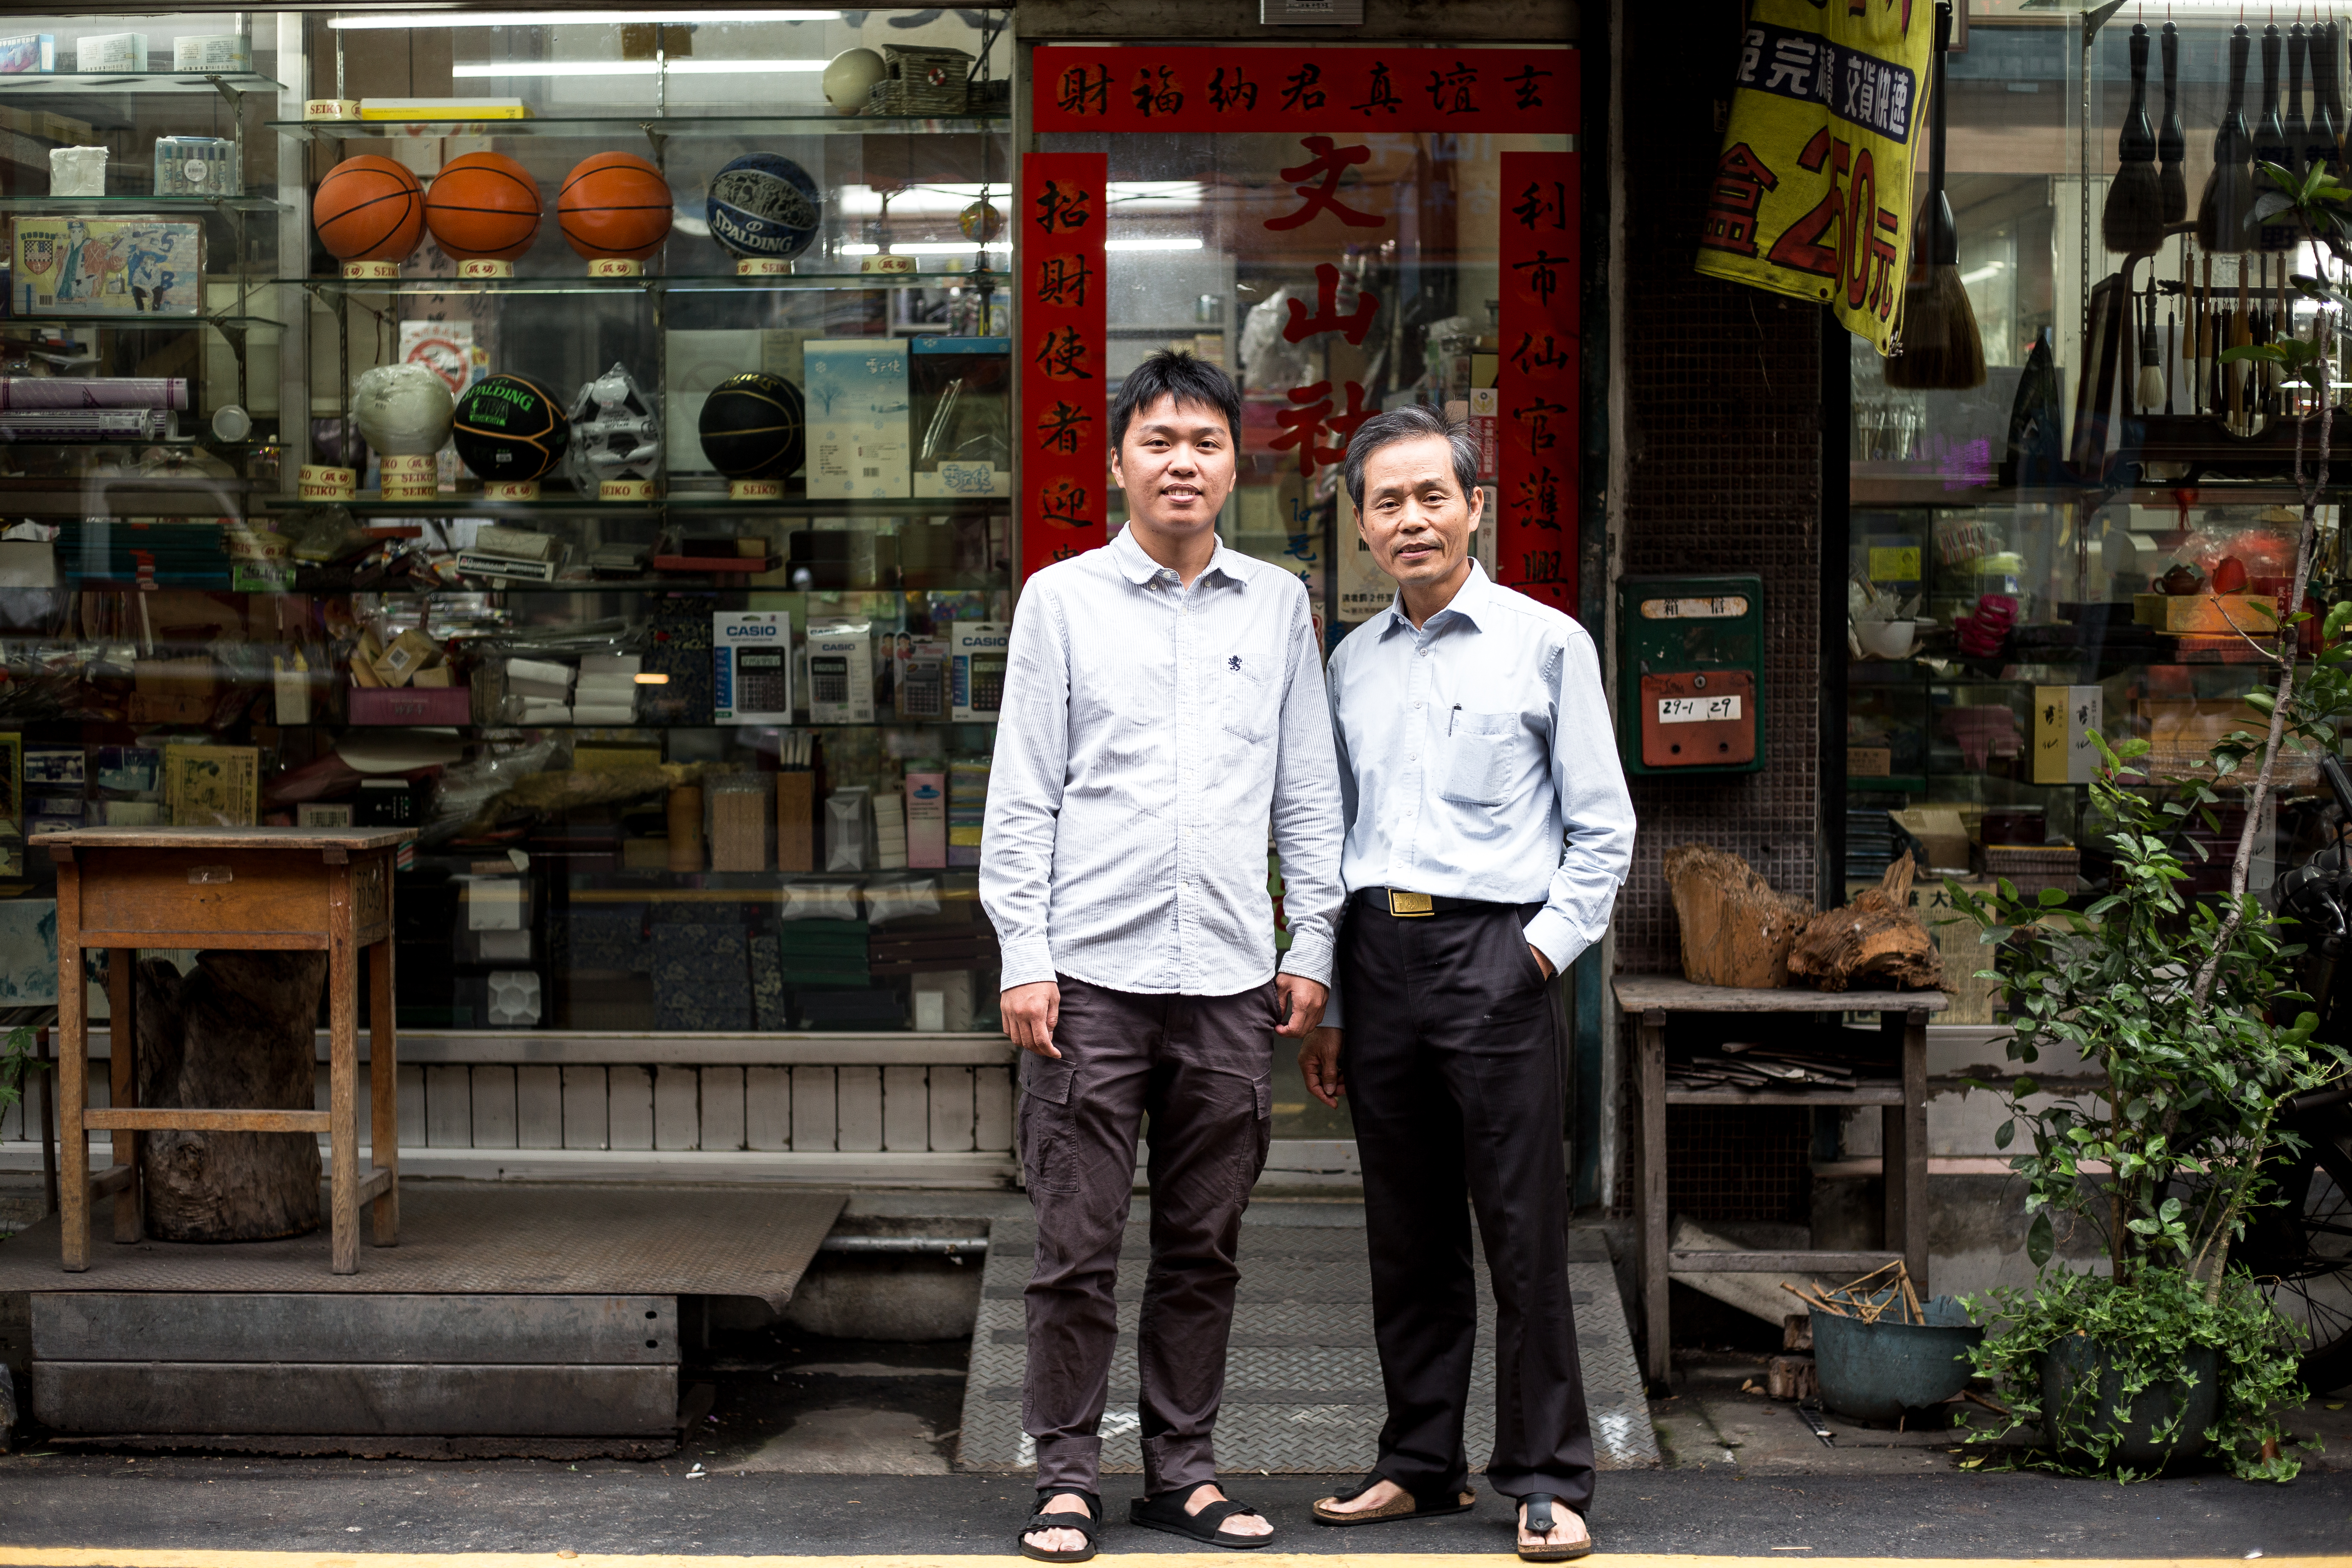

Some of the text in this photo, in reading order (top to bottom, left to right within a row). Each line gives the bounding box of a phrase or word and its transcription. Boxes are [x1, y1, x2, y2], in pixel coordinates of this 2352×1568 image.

[1845, 56, 1909, 135] 交貨快速
[310, 104, 343, 114] SEIKO
[713, 209, 793, 253] SPALDING
[374, 266, 398, 276] SEIK
[469, 265, 493, 274] 成功
[602, 264, 628, 273] 成功
[762, 263, 789, 273] SEIK
[1264, 136, 1386, 477] 文山社
[462, 385, 535, 412] SPALDING
[402, 474, 433, 483] SEIKO
[304, 486, 336, 497] SEIKO
[402, 487, 434, 497] SEIKO
[601, 485, 631, 496] SEIKO
[743, 485, 777, 495] SEIKO
[726, 626, 776, 636] CASIO
[962, 637, 1007, 646] CASIO
[1663, 698, 1731, 717] 29-1 29
